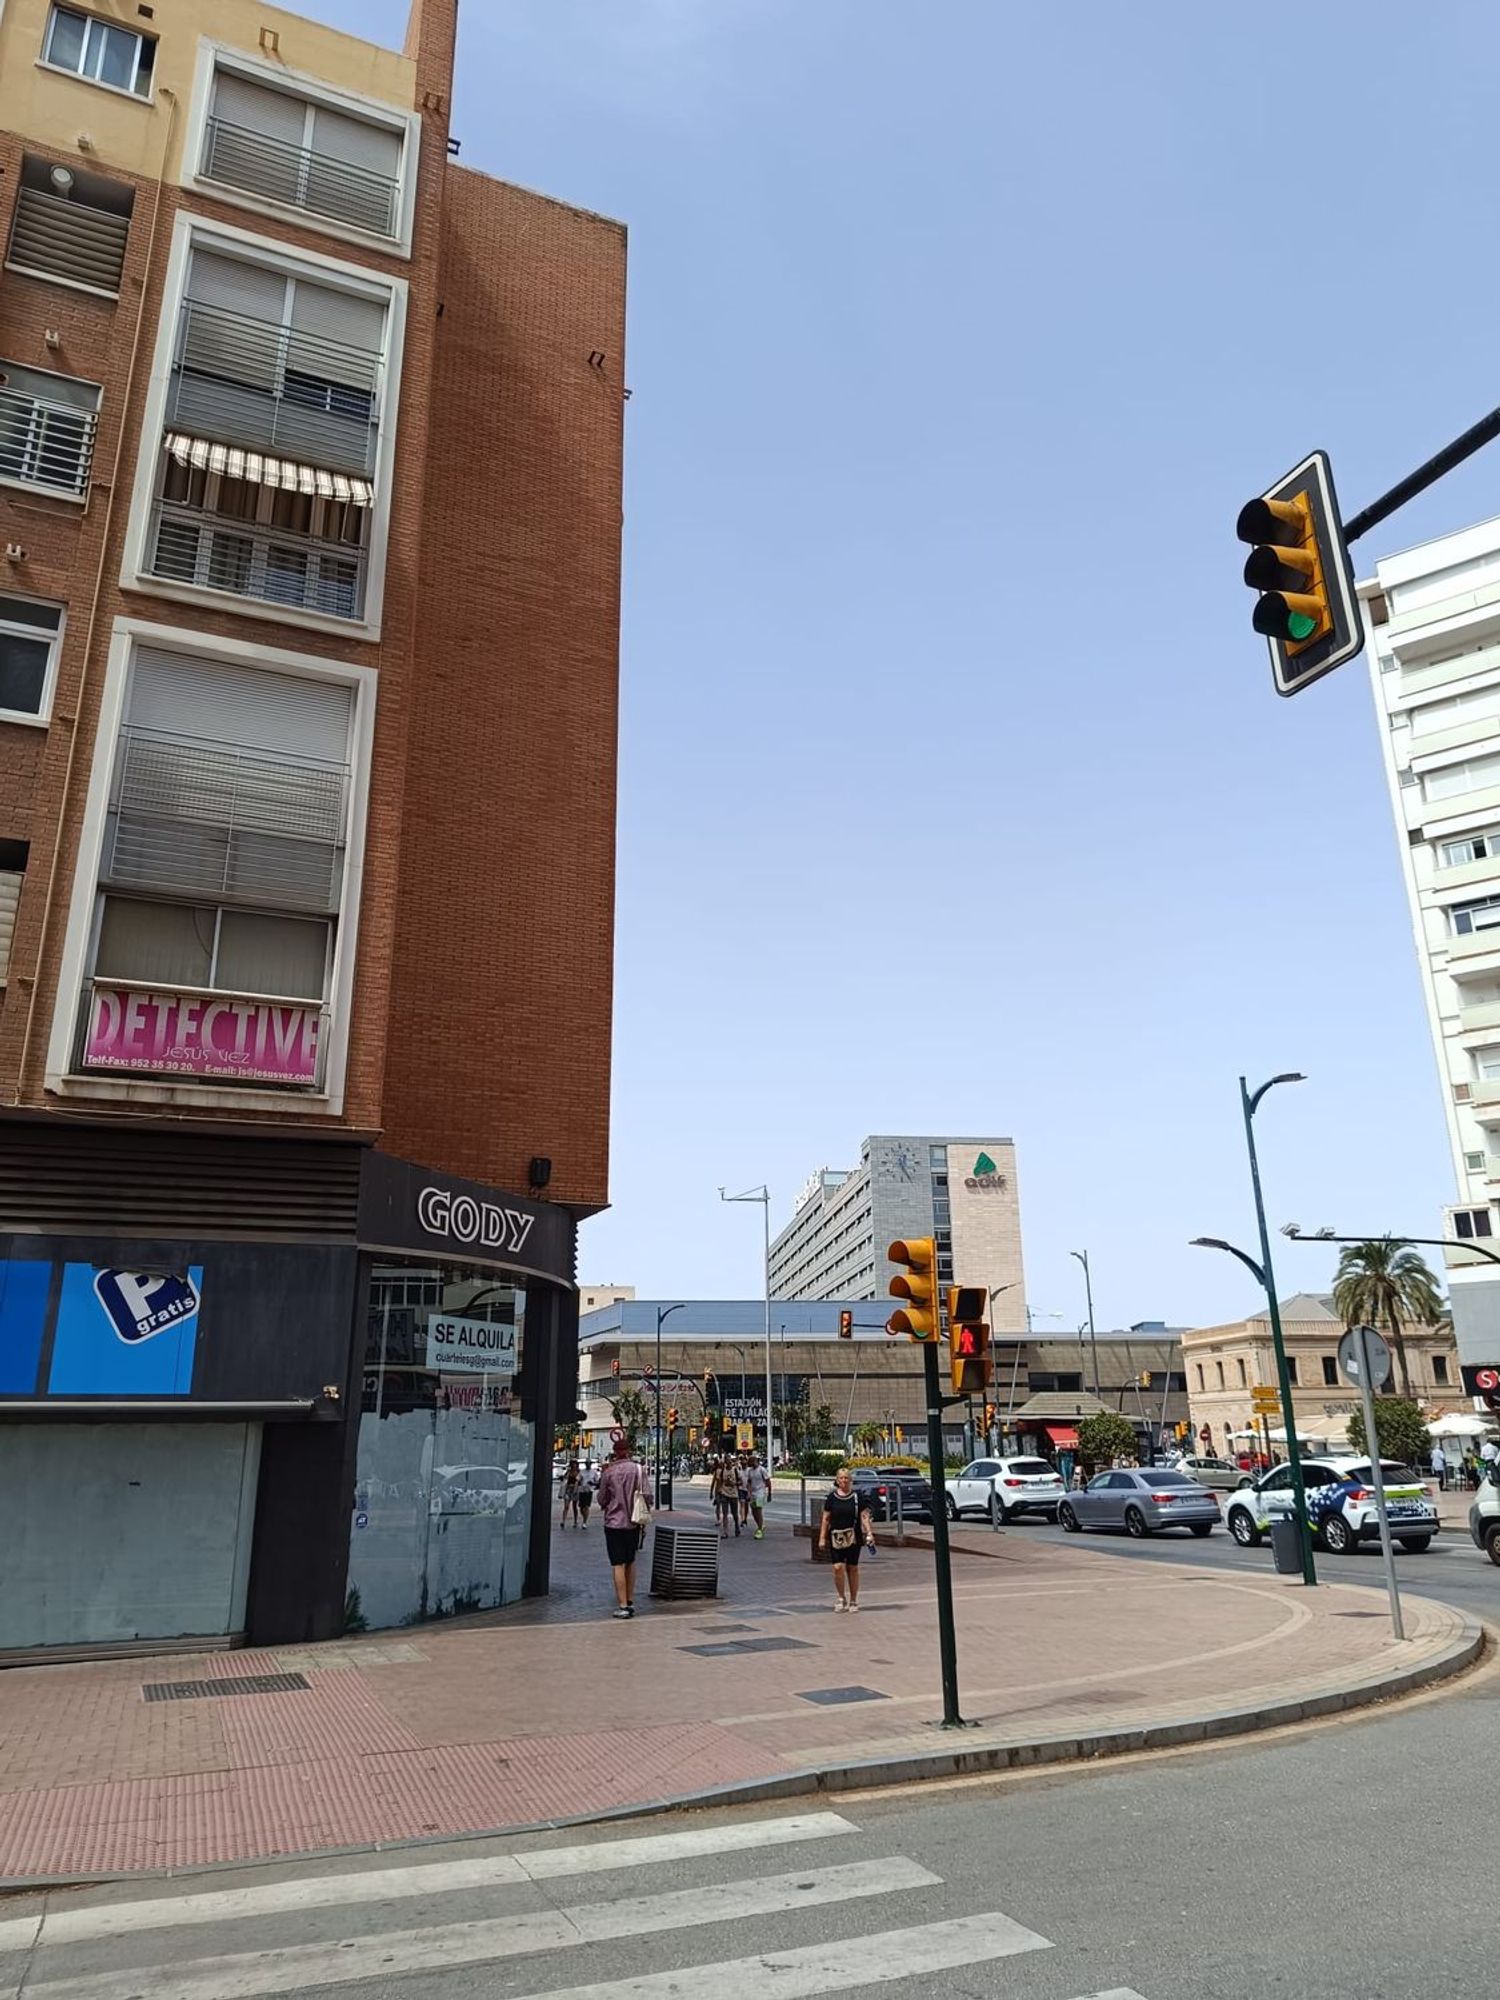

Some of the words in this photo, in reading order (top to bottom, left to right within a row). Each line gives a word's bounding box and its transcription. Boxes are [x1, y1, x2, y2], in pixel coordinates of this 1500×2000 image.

[88, 990, 319, 1068] DETECTIVE
[130, 1058, 150, 1068] 952
[166, 1061, 179, 1070] 30
[418, 1186, 535, 1253] GODY
[136, 1297, 195, 1335] gratis
[434, 1322, 455, 1345] SE
